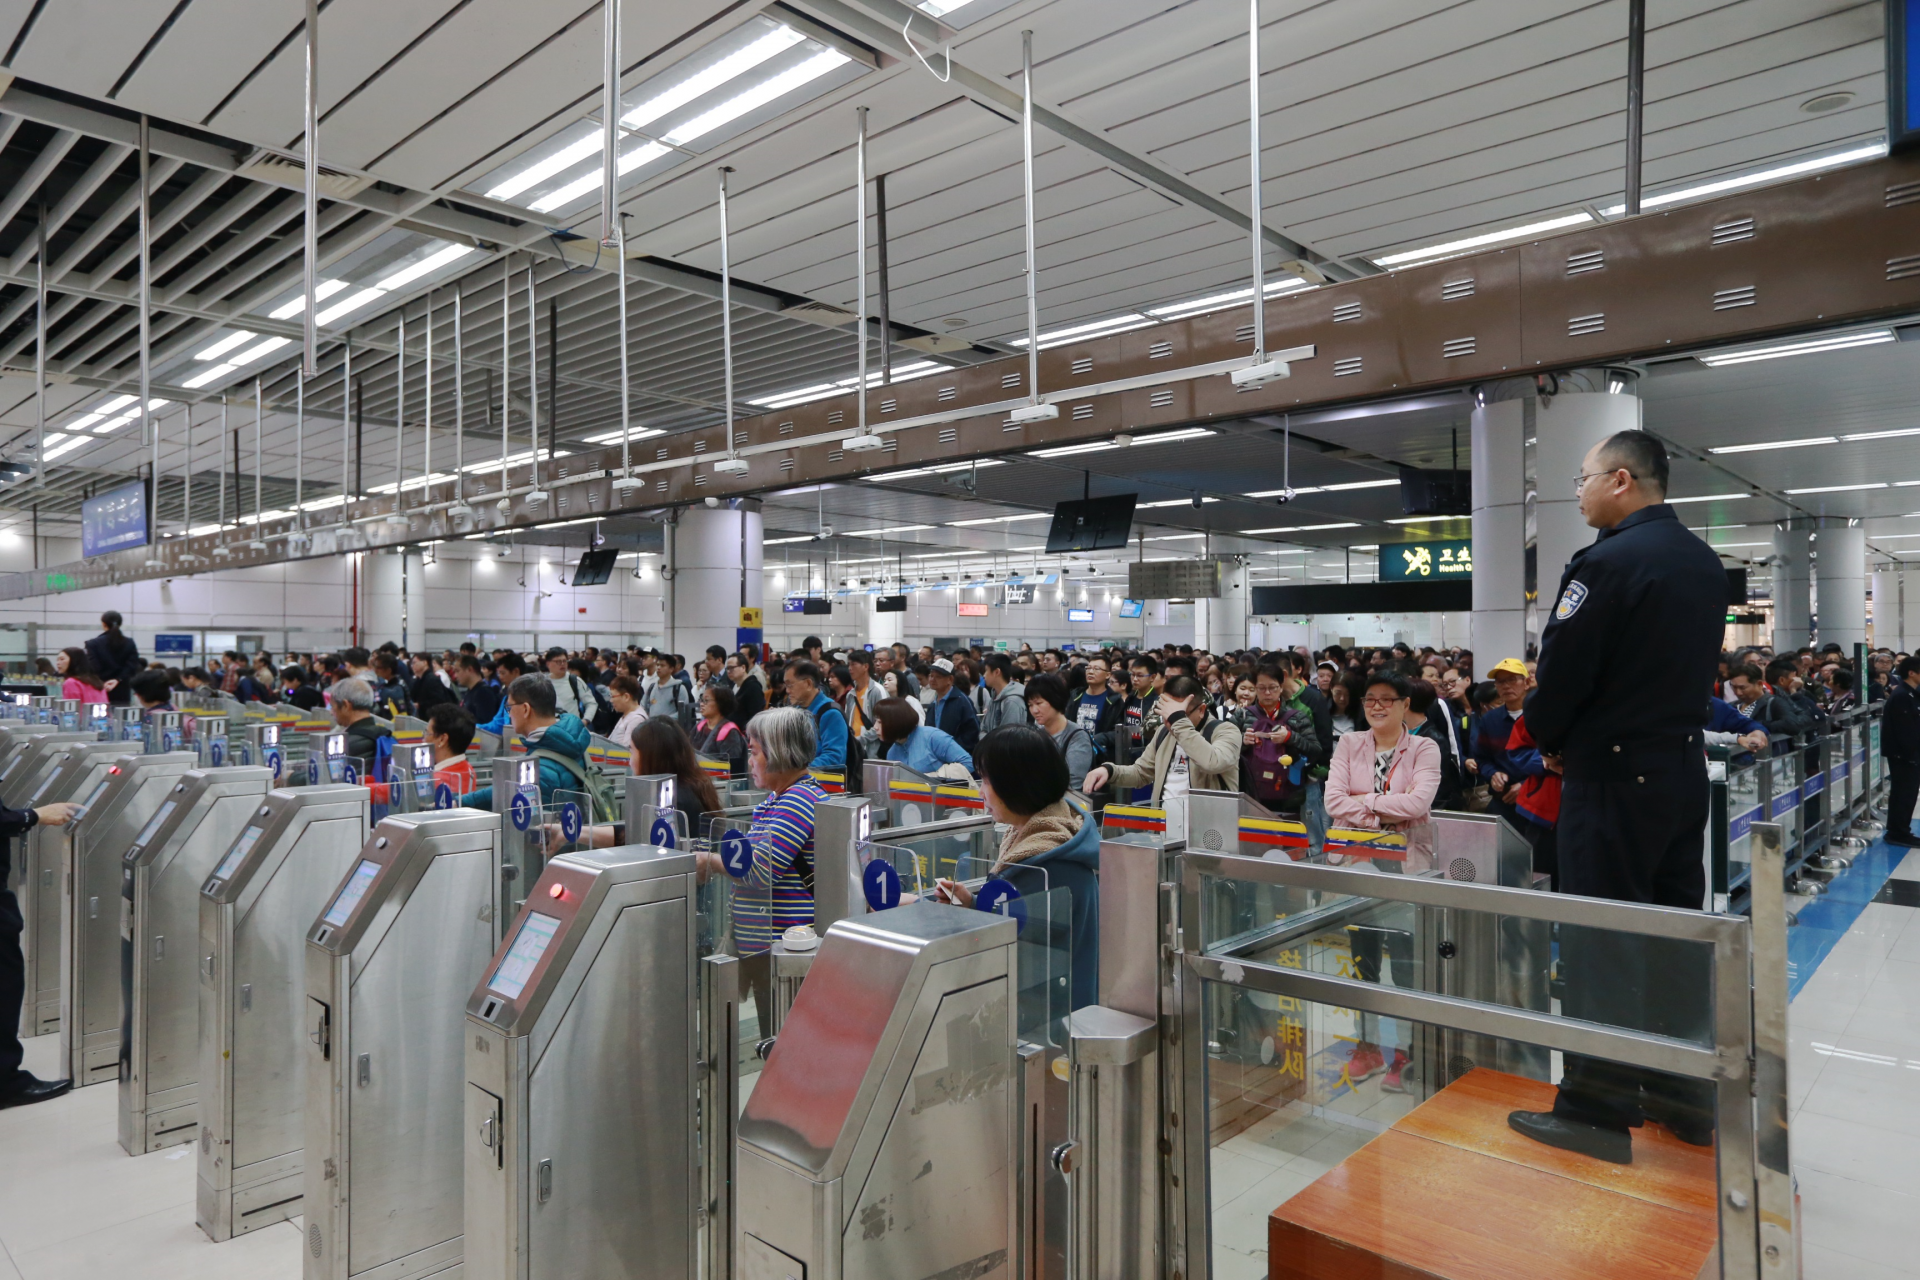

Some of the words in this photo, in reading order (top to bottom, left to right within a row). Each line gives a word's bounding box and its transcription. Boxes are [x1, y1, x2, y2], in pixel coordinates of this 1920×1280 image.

[1439, 546, 1472, 562] 卫生
[1439, 563, 1464, 572] Health
[1465, 563, 1472, 571] Q
[271, 758, 277, 774] 6
[310, 762, 316, 781] 5
[346, 772, 352, 784] 5
[393, 781, 398, 801] 4
[439, 790, 447, 809] 4
[516, 800, 525, 824] 3
[567, 810, 576, 835] 3
[657, 827, 667, 847] 2
[729, 839, 743, 869] 2
[876, 871, 887, 904] 1
[993, 892, 1009, 917] 1
